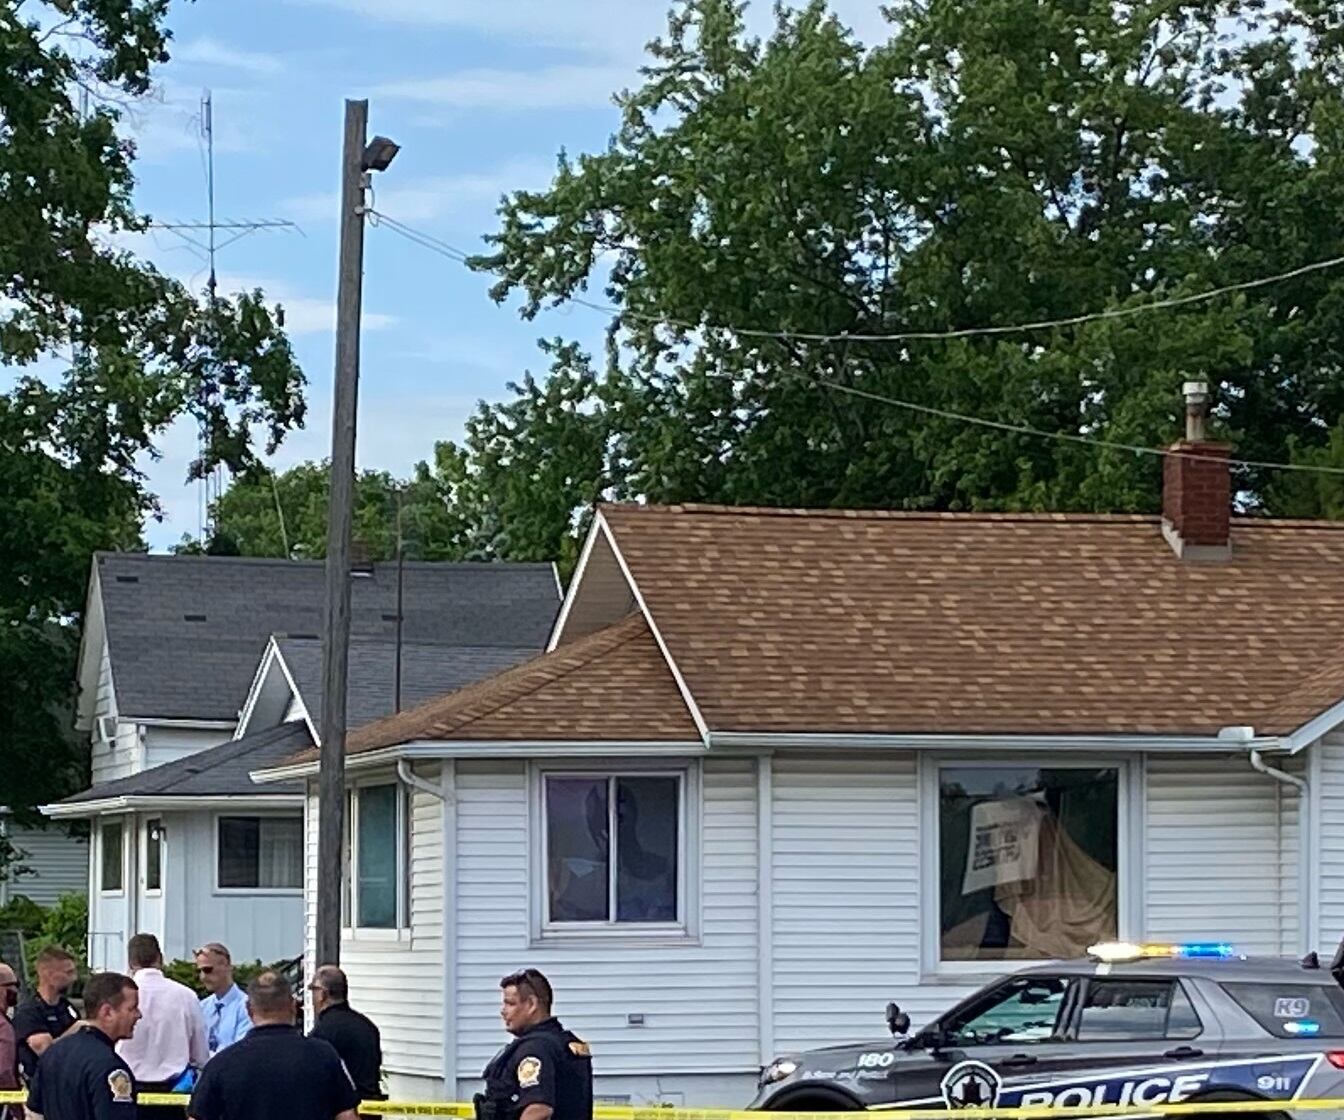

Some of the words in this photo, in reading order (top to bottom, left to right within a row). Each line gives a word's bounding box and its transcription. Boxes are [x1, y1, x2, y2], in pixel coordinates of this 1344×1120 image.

[857, 1052, 894, 1067] 180
[1257, 1075, 1290, 1090] 911
[1016, 1073, 1209, 1118] POLICE
